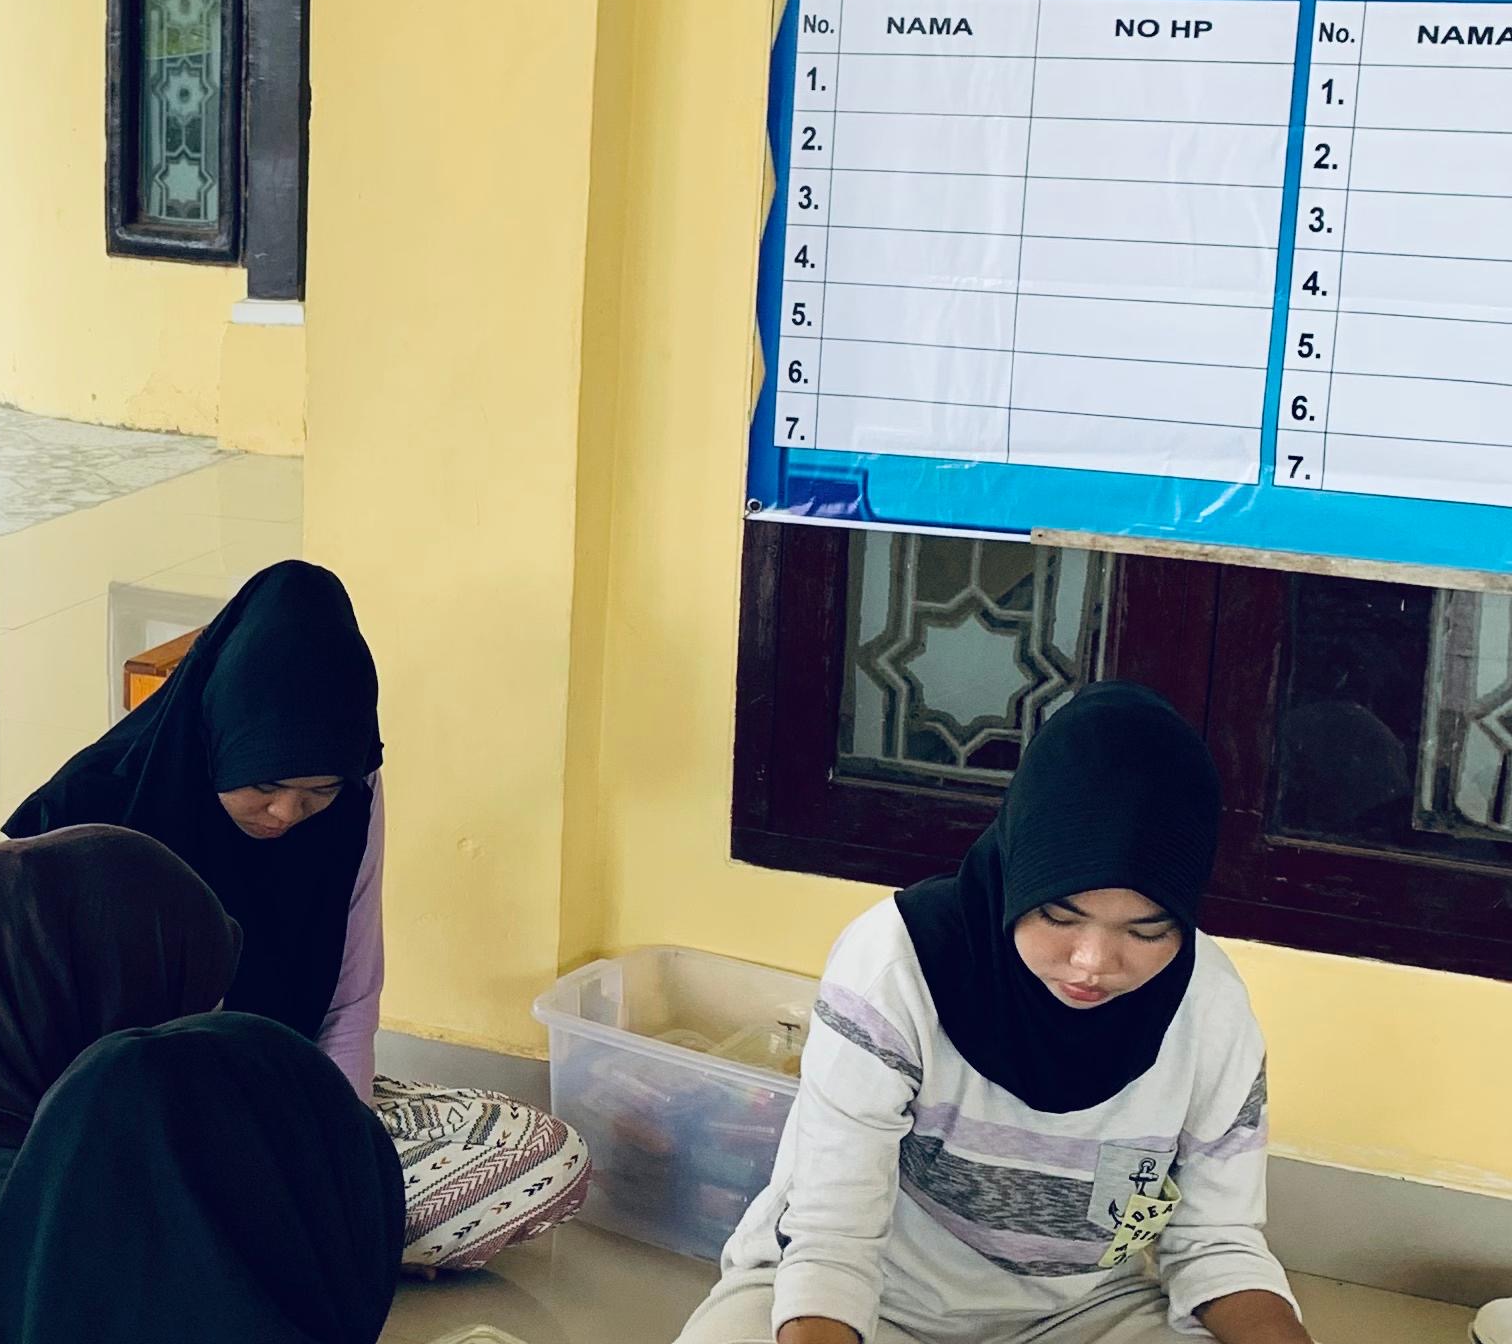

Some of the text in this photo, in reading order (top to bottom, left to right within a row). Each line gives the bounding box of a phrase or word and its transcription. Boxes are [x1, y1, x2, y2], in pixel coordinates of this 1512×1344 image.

[803, 14, 1213, 39] No. NAMA NO HP
[1318, 22, 1512, 46] No. NAMA
[806, 66, 827, 92] 1.
[1321, 78, 1344, 105] 1.
[801, 126, 823, 151] 2.
[1313, 143, 1338, 170] 2.
[798, 185, 819, 210] 3.
[1308, 206, 1333, 234] 3.
[794, 244, 816, 269] 4.
[1301, 270, 1327, 297] 4.
[791, 302, 812, 327] 5.
[1297, 332, 1321, 359] 5.
[788, 359, 809, 384] 6.
[1291, 395, 1315, 422] 6.
[785, 416, 805, 441] 7.
[1287, 454, 1311, 480] 7.
